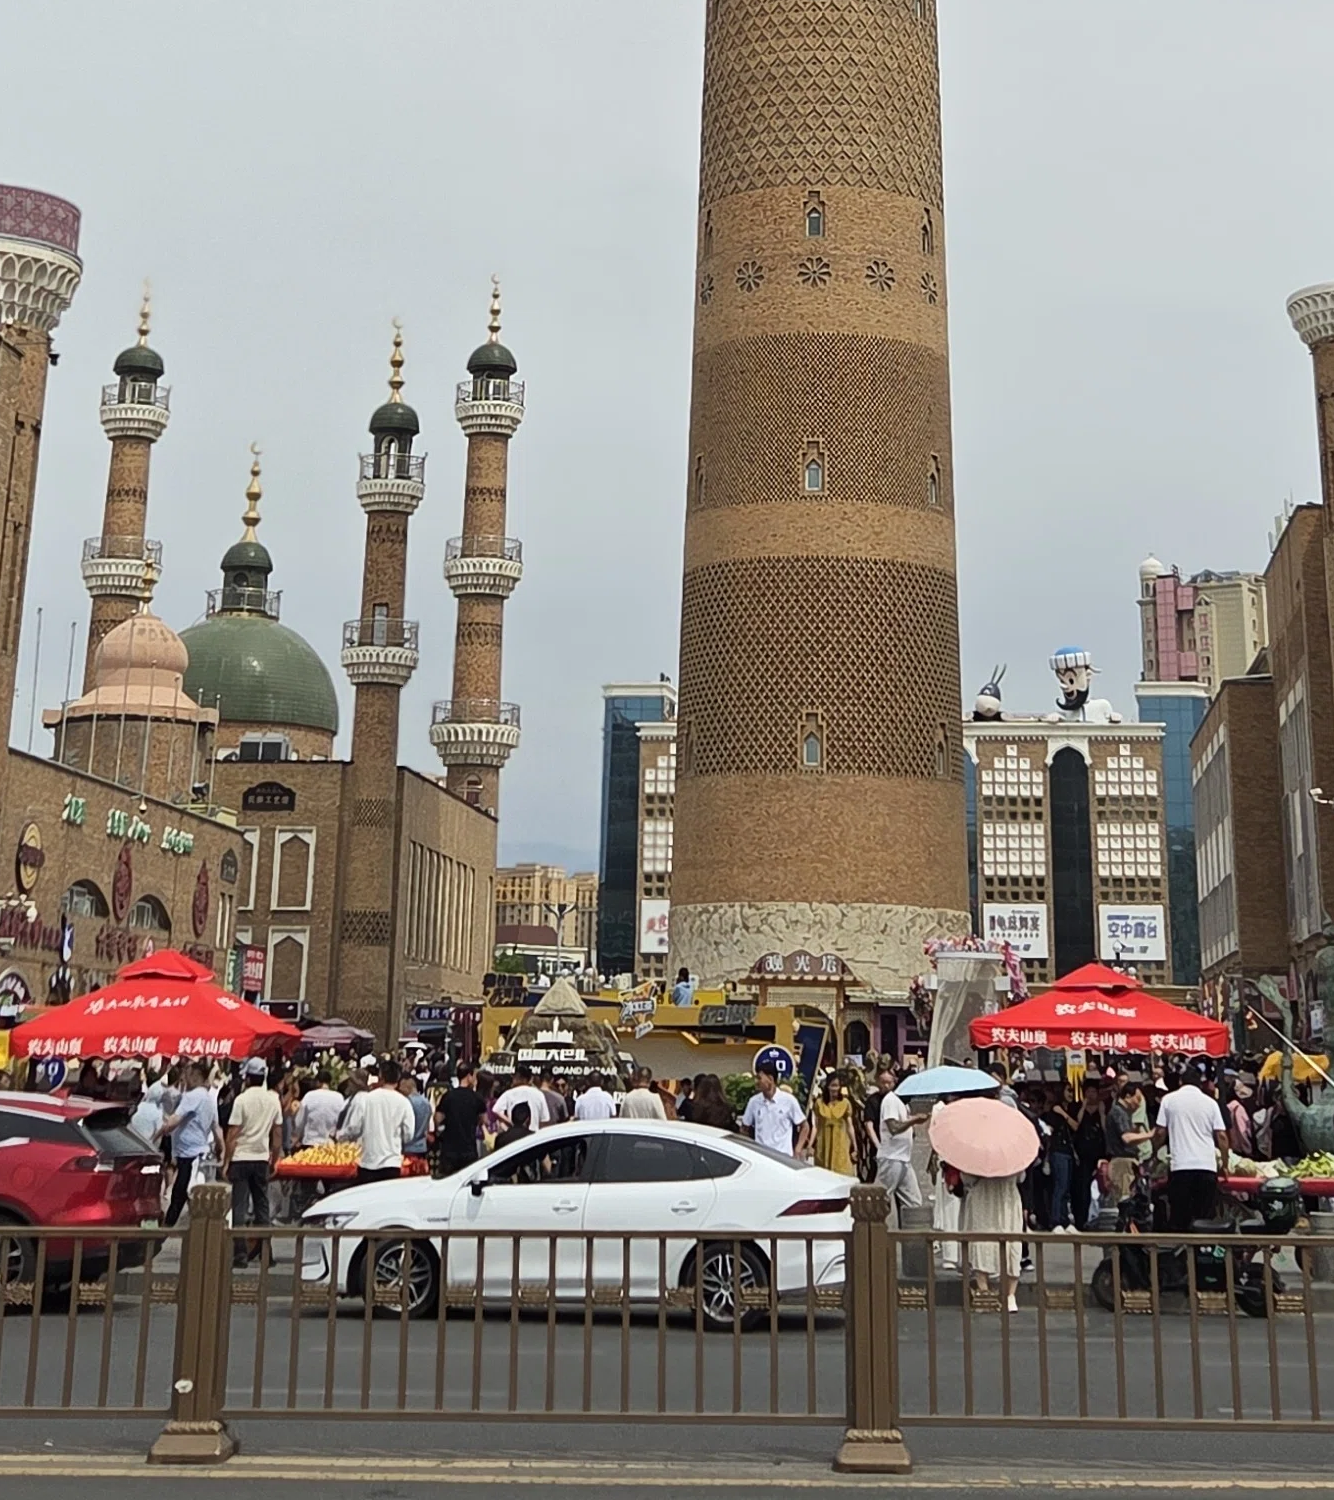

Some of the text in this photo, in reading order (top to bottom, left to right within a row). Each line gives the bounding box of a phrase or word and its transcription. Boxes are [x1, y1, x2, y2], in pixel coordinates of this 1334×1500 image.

[1107, 922, 1158, 940] 空中露台
[765, 954, 838, 974] 观光塔
[103, 1036, 159, 1054] 农夫山泉
[991, 1027, 1048, 1045] 农夫山泉
[1070, 1031, 1128, 1048] 农夫山泉
[1149, 1034, 1208, 1051] 农夫山泉
[27, 1037, 84, 1056] 农夫山泉
[177, 1037, 235, 1055] 农夫山泉
